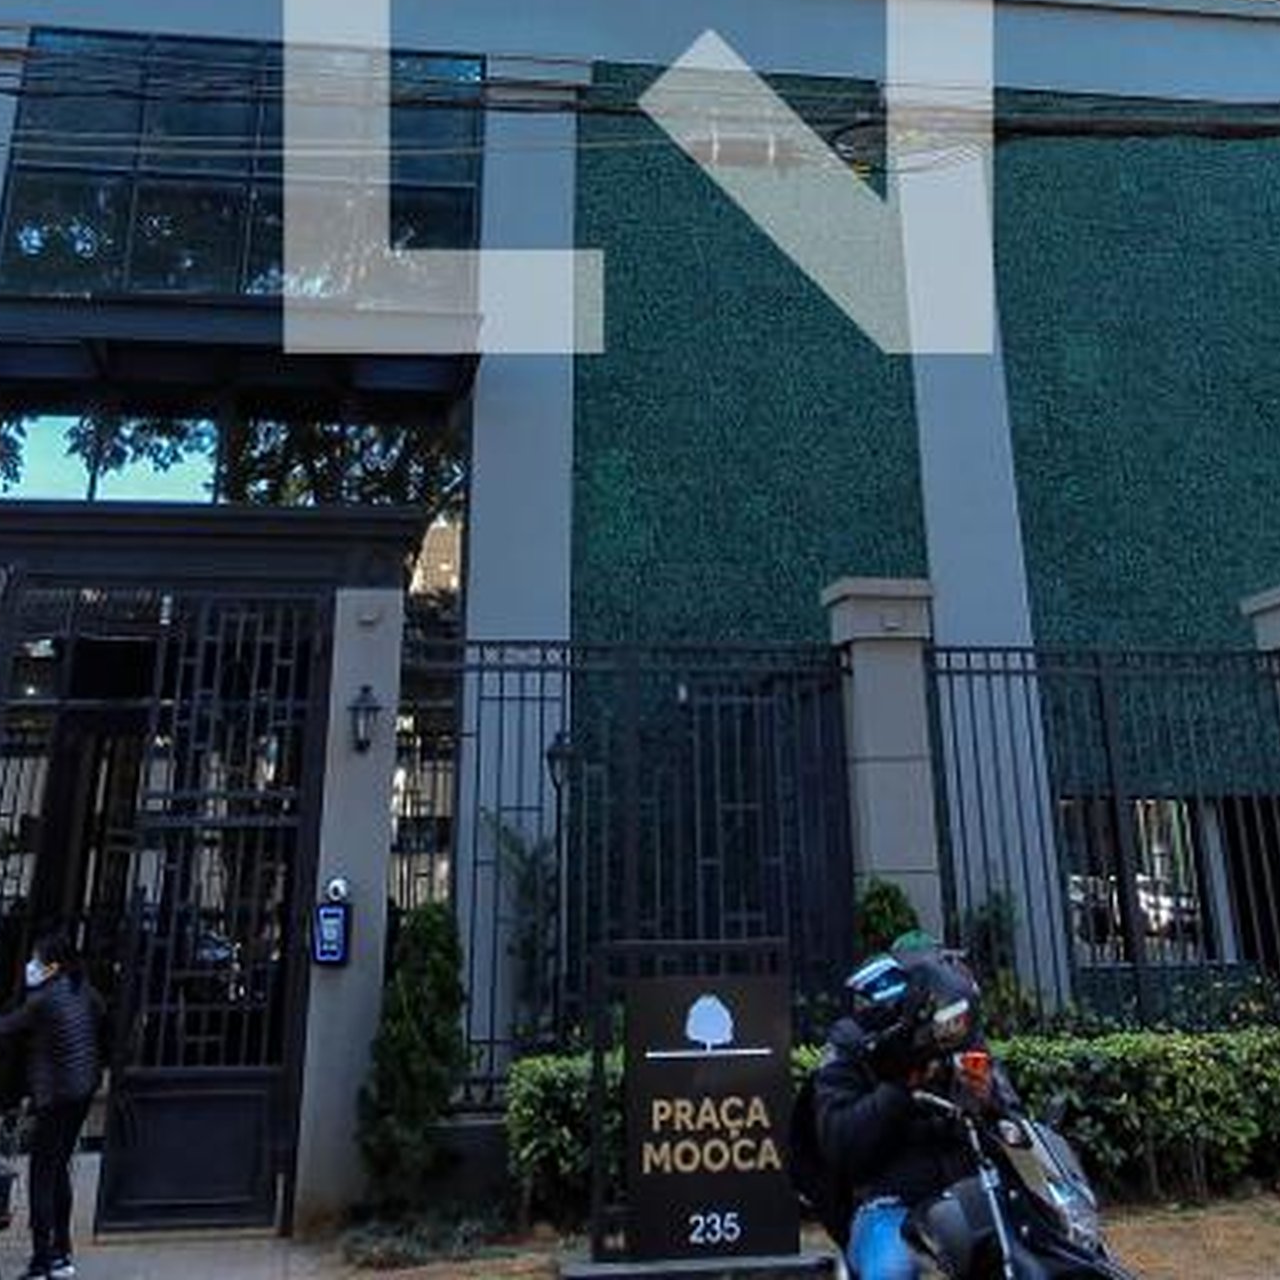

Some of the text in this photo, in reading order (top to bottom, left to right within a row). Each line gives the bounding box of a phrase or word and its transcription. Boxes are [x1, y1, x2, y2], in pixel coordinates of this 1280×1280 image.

[652, 1096, 771, 1138] PRAÇA
[642, 1138, 782, 1174] MOOCA
[688, 1213, 741, 1244] 235
